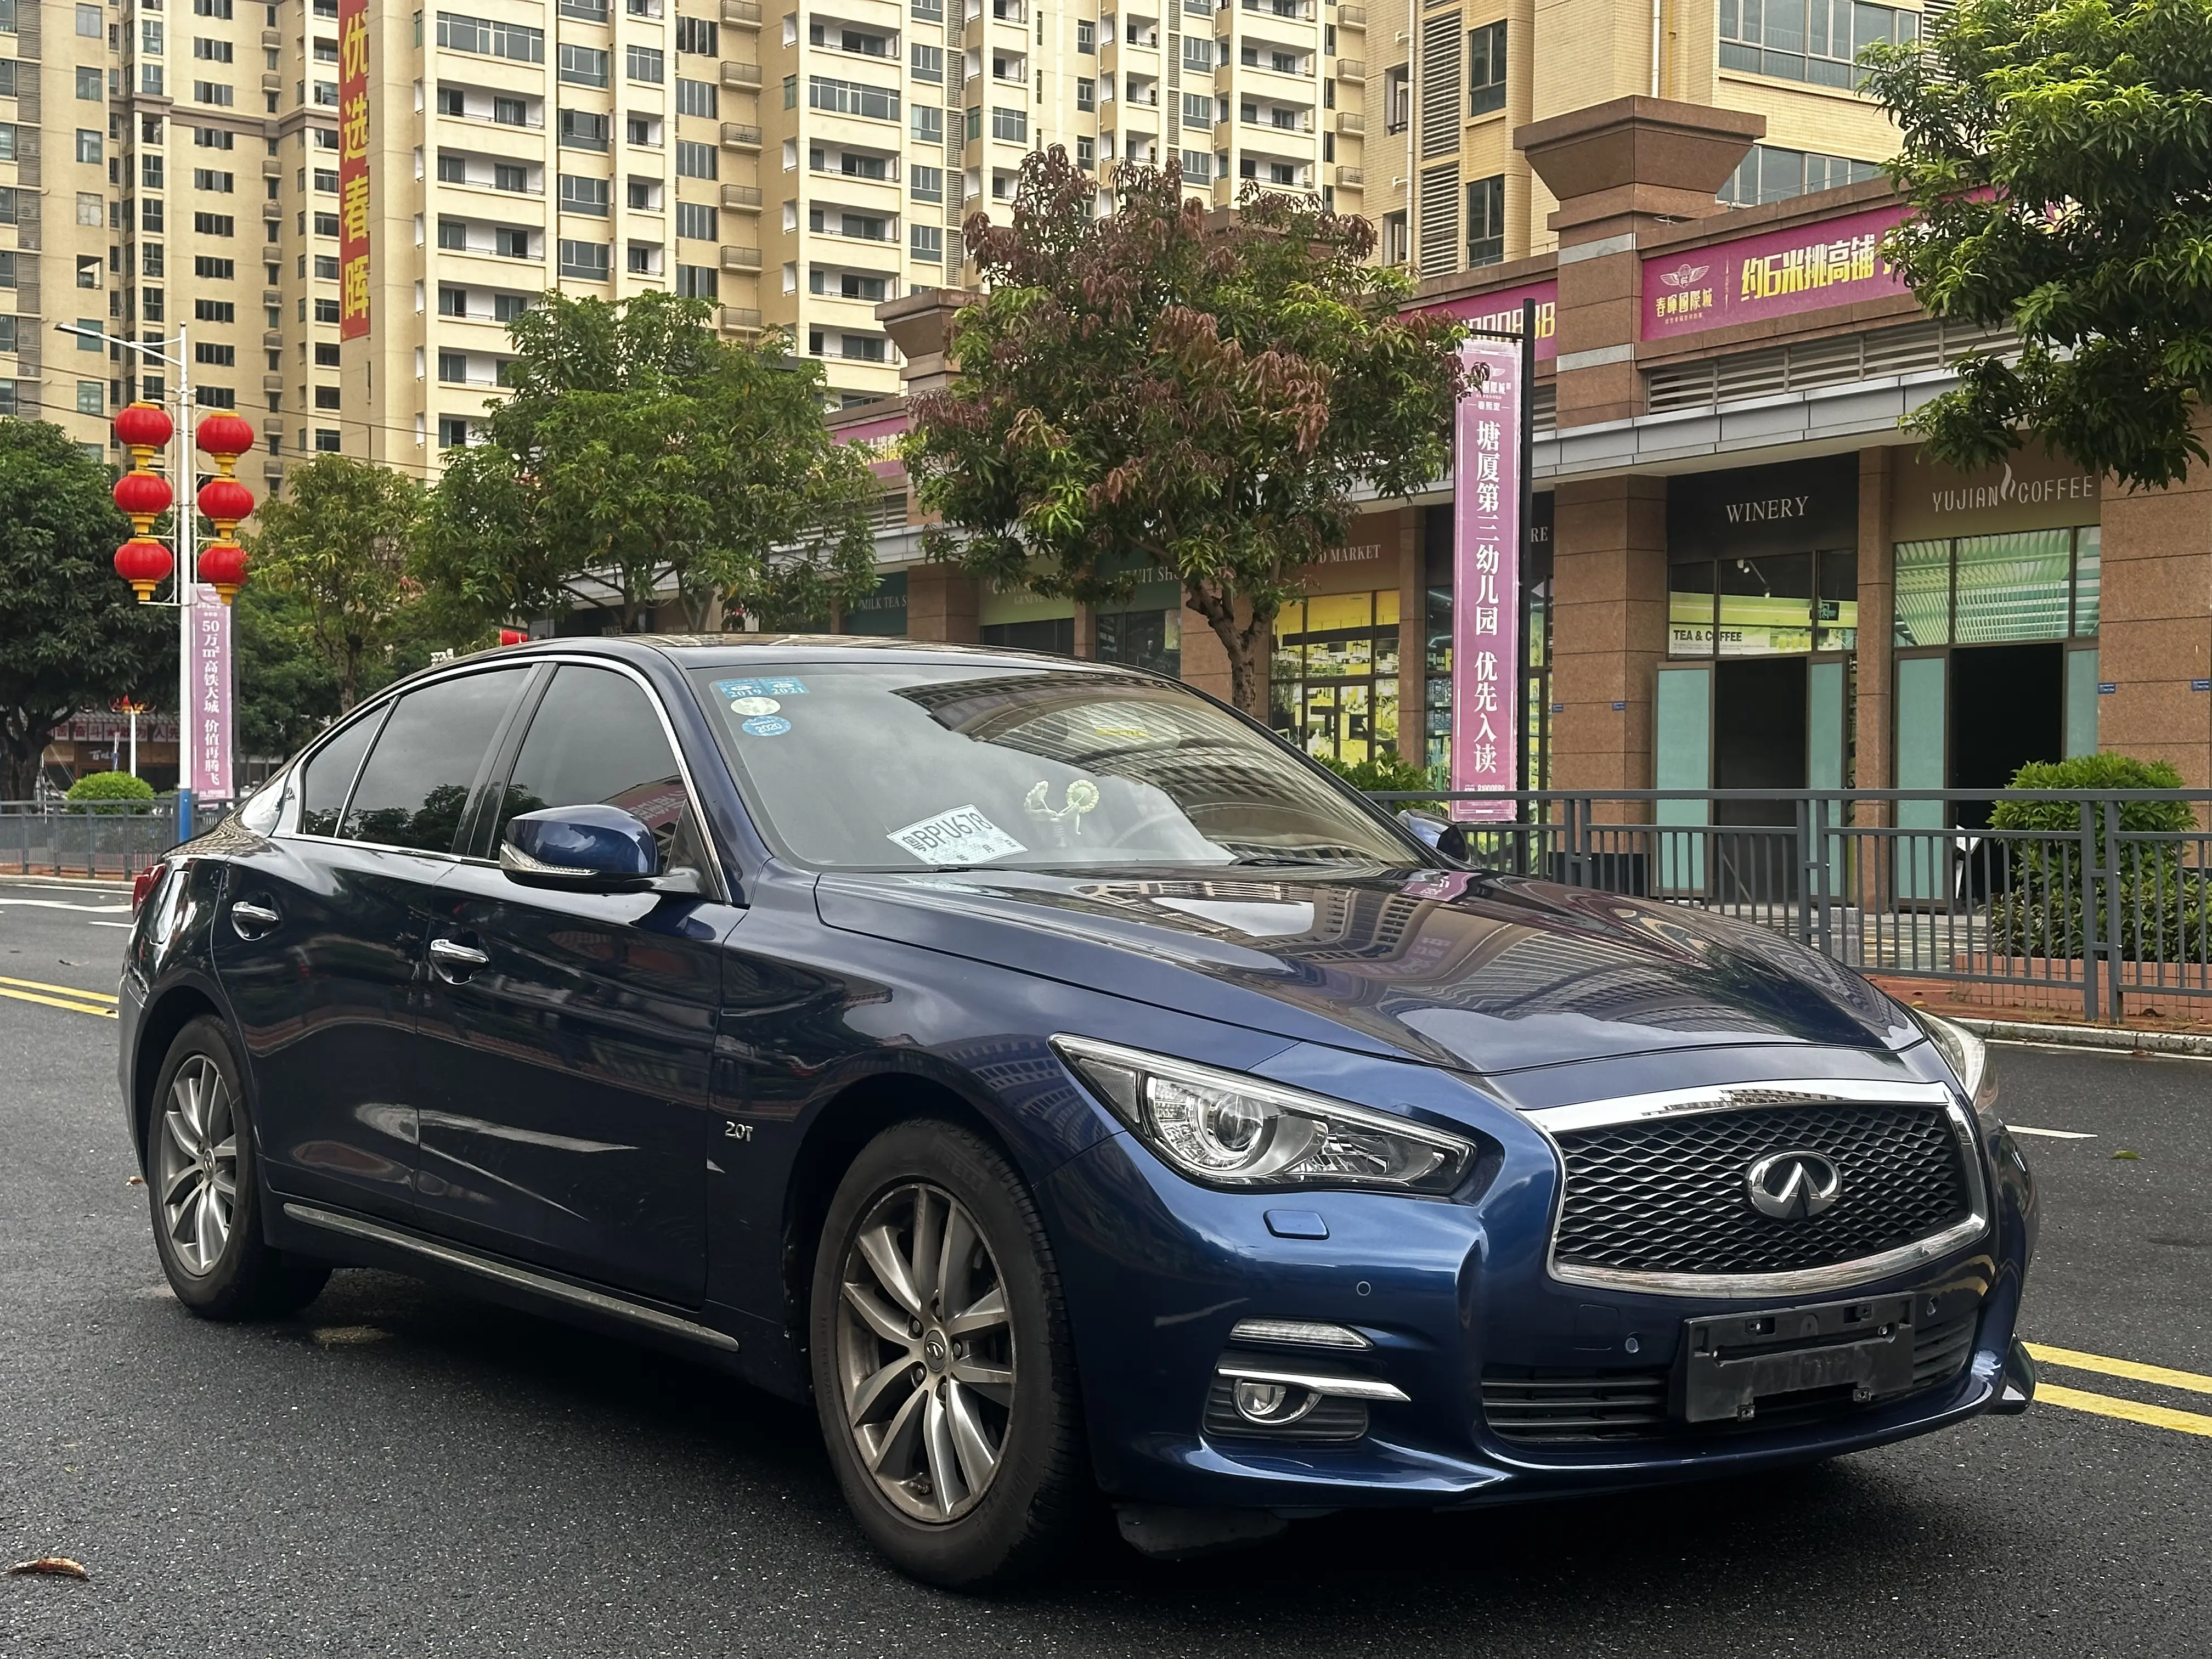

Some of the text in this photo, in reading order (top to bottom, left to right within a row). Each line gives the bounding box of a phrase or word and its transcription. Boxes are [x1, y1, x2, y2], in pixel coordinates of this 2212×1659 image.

[343, 11, 369, 320] 优选春晖
[1740, 234, 1875, 301] 约6米挑高铺
[1932, 475, 2094, 512] YUJIAN COFFEE
[1725, 495, 1810, 523] WINERY
[1475, 420, 1501, 636] 塘厦第三幼儿园
[1329, 544, 1381, 563] MARKET
[884, 596, 900, 608] TEA
[1673, 629, 1742, 642] TEA & CFFEE
[729, 686, 806, 698] 2019 2021
[1473, 651, 1498, 774] 优先入读
[755, 723, 783, 733] 2020
